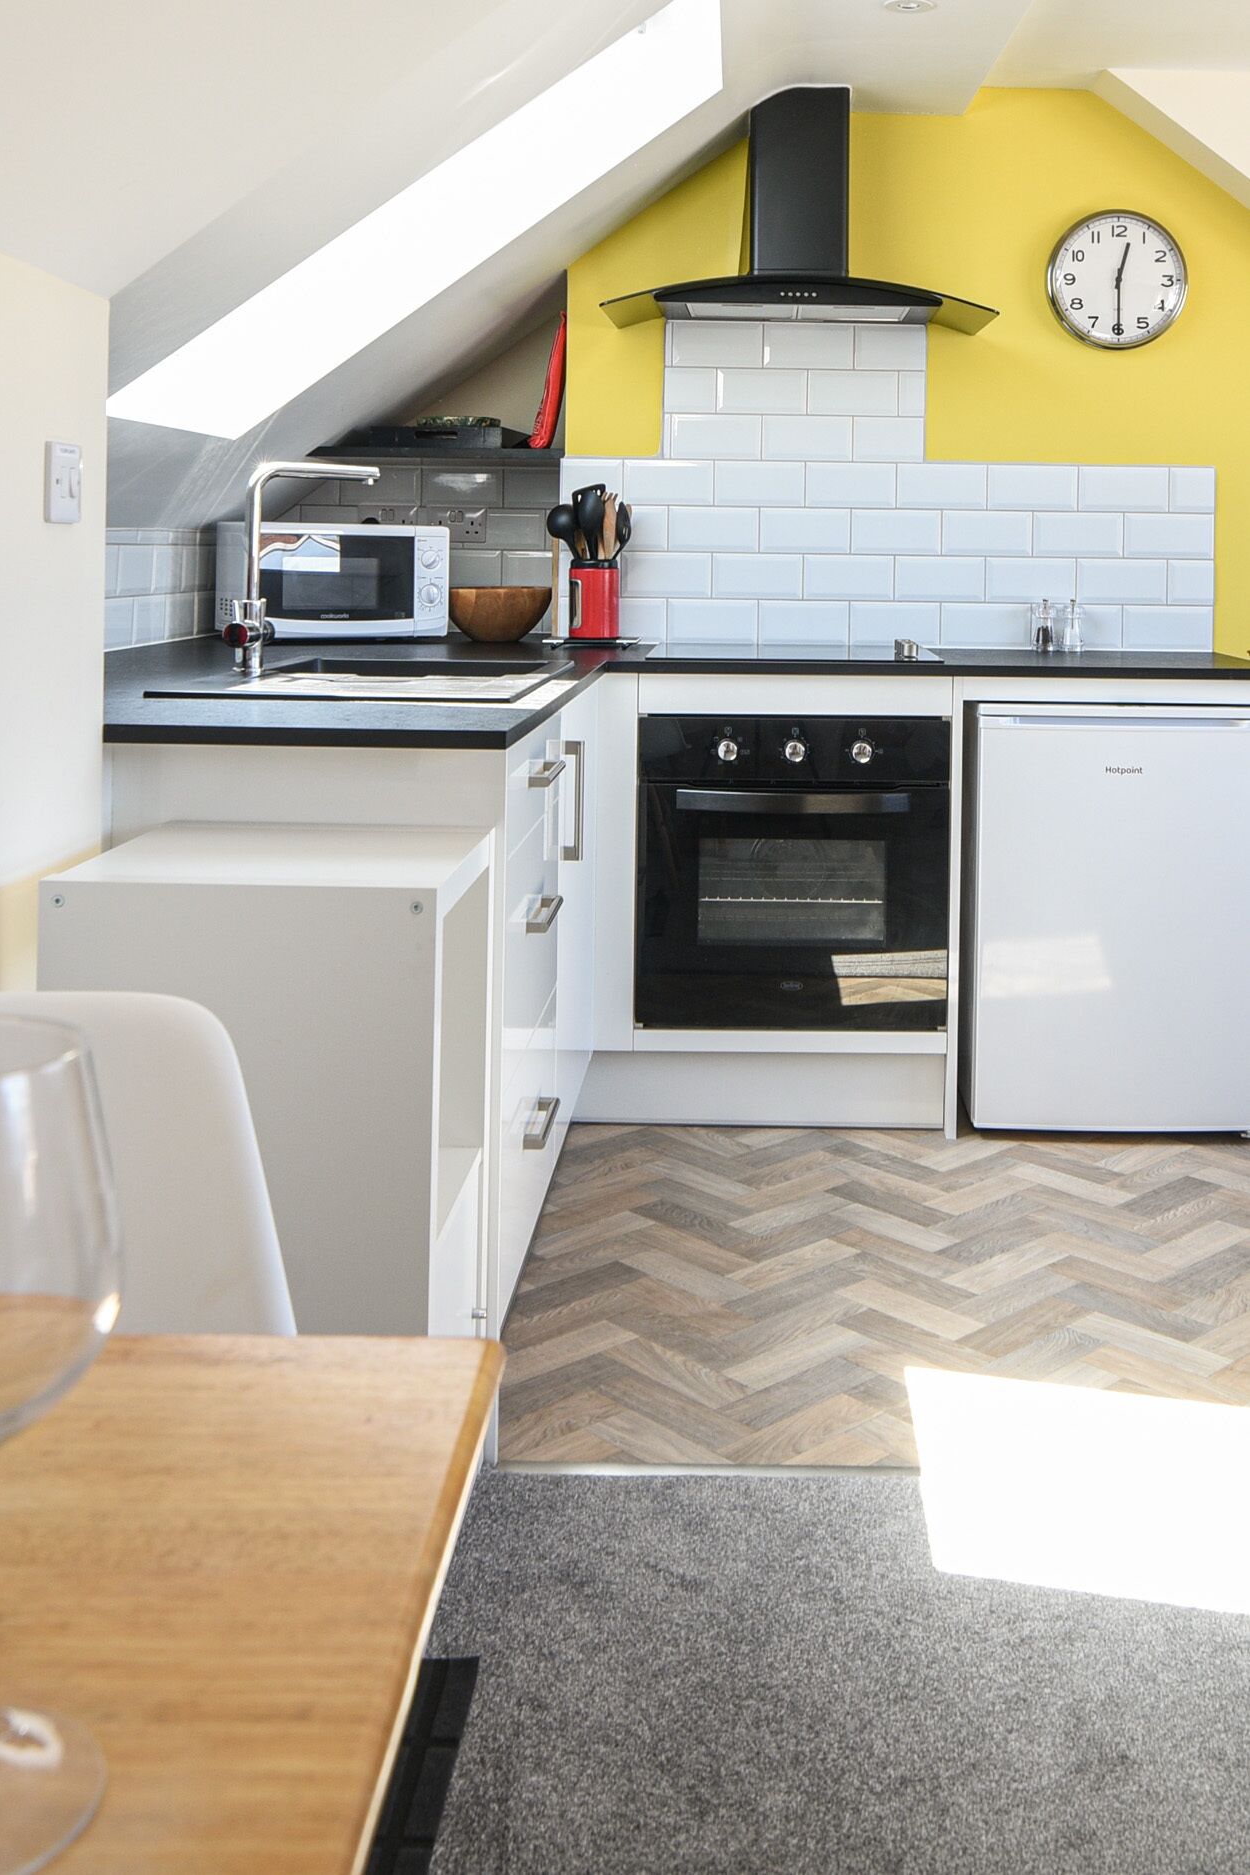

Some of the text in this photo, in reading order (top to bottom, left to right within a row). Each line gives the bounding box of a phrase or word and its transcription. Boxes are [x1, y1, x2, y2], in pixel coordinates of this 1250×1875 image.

[1091, 231, 1100, 244] 11
[1111, 225, 1128, 238] 12
[1072, 249, 1085, 262] 10
[1154, 250, 1167, 263] 2
[1063, 273, 1076, 286] 9
[1161, 275, 1174, 288] 3
[1070, 297, 1084, 311] 8
[1088, 316, 1099, 329] 7
[1136, 317, 1149, 329] 5
[1112, 323, 1124, 336] 6
[1105, 766, 1143, 775] Hotpoint
